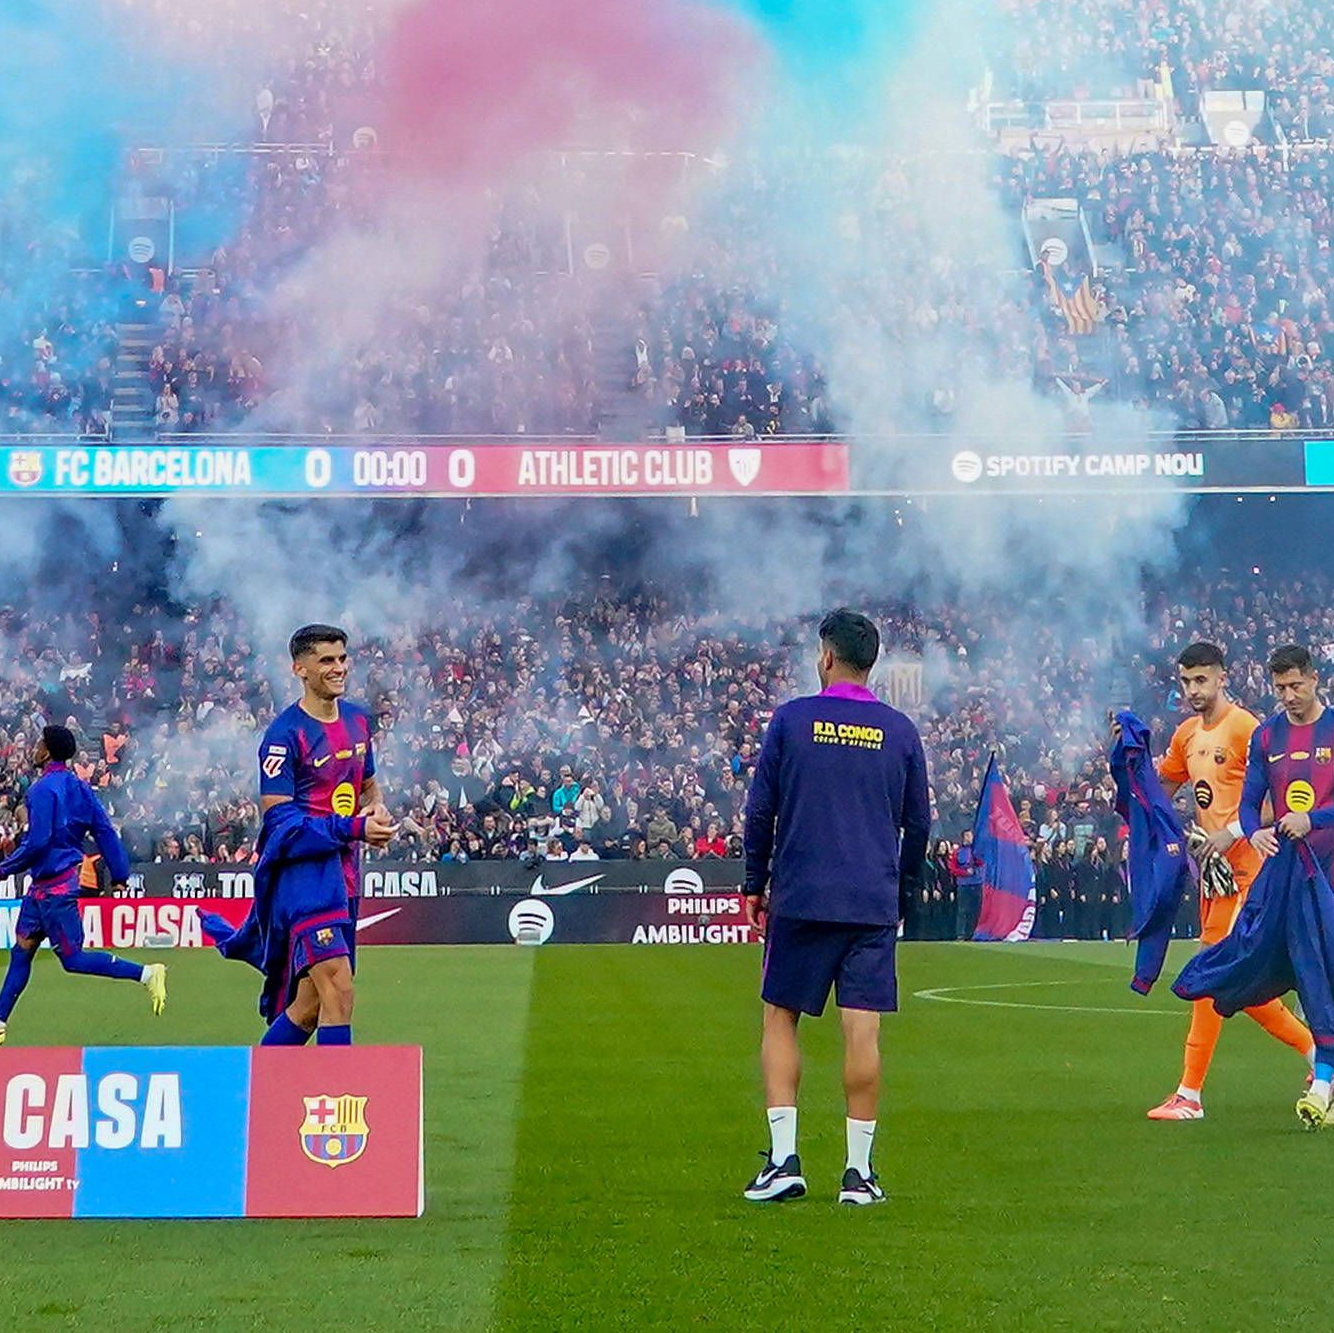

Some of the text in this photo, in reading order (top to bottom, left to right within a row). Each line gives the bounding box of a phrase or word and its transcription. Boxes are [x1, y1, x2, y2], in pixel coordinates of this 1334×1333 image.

[54, 448, 713, 488] FC BARCELONA 0 00:00 0 ATHLETIC CLUB
[986, 452, 1204, 478] SPOTIFY CAMP NOU
[838, 724, 883, 742] CONGO
[668, 898, 740, 914] PHILIPS
[83, 906, 103, 948] A
[112, 905, 203, 948] CASA
[632, 925, 751, 943] AMBILIGHT
[2, 1073, 183, 1150] CASA
[11, 1161, 58, 1172] PHILIPS
